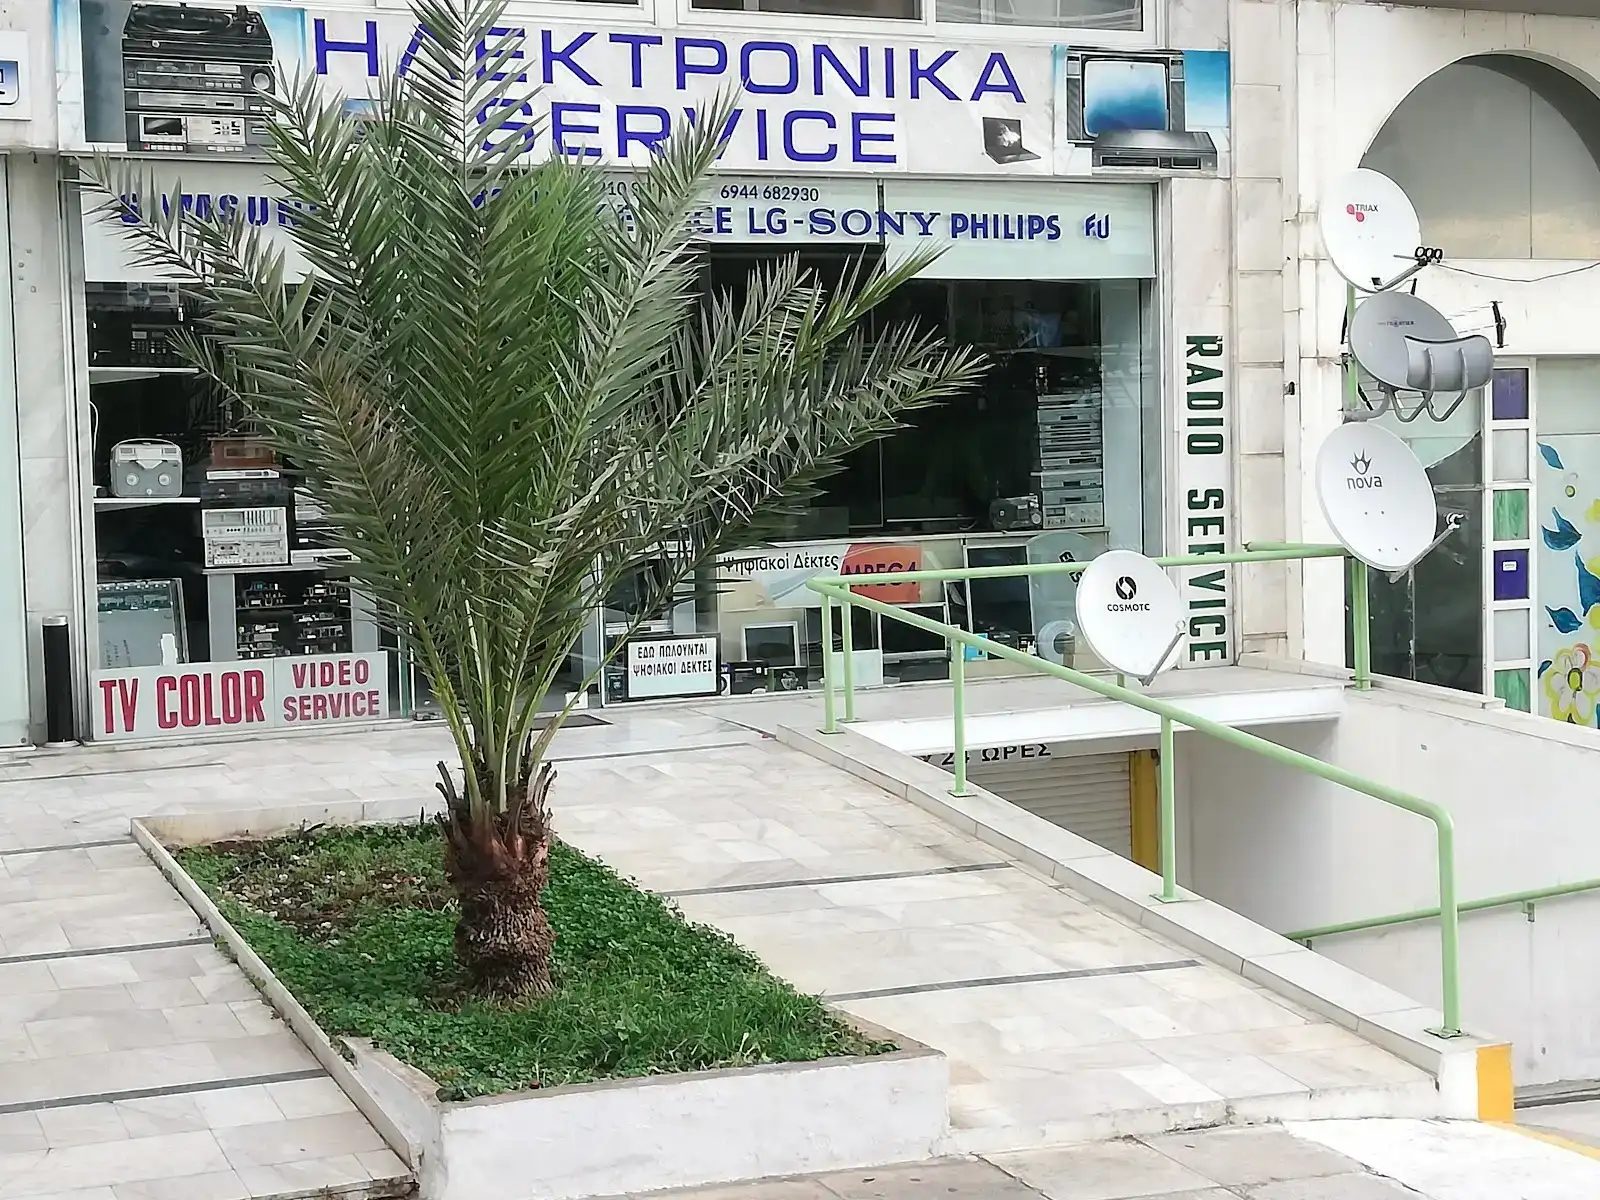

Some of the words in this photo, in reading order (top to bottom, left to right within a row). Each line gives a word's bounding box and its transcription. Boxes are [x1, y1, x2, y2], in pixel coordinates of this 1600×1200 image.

[720, 184, 758, 200] 6944
[763, 185, 819, 202] 682930
[1355, 203, 1379, 213] TRIAX
[950, 213, 1062, 240] PHILIPS
[1185, 334, 1225, 455] RADIO
[1346, 476, 1383, 490] nova
[793, 552, 840, 570] Δέκτες
[637, 645, 655, 659] ΕΔΩ
[659, 642, 708, 658] ΠΩΛΟΥΝΤΑΙ
[291, 658, 370, 689] VIDEO
[632, 661, 677, 677] ΨΗΦΙΑΚΟΙ
[680, 659, 713, 674] ΔΕΚΤΕΣ
[98, 677, 139, 735] TV
[156, 669, 266, 730] COLOR
[282, 690, 381, 723] SERVICE
